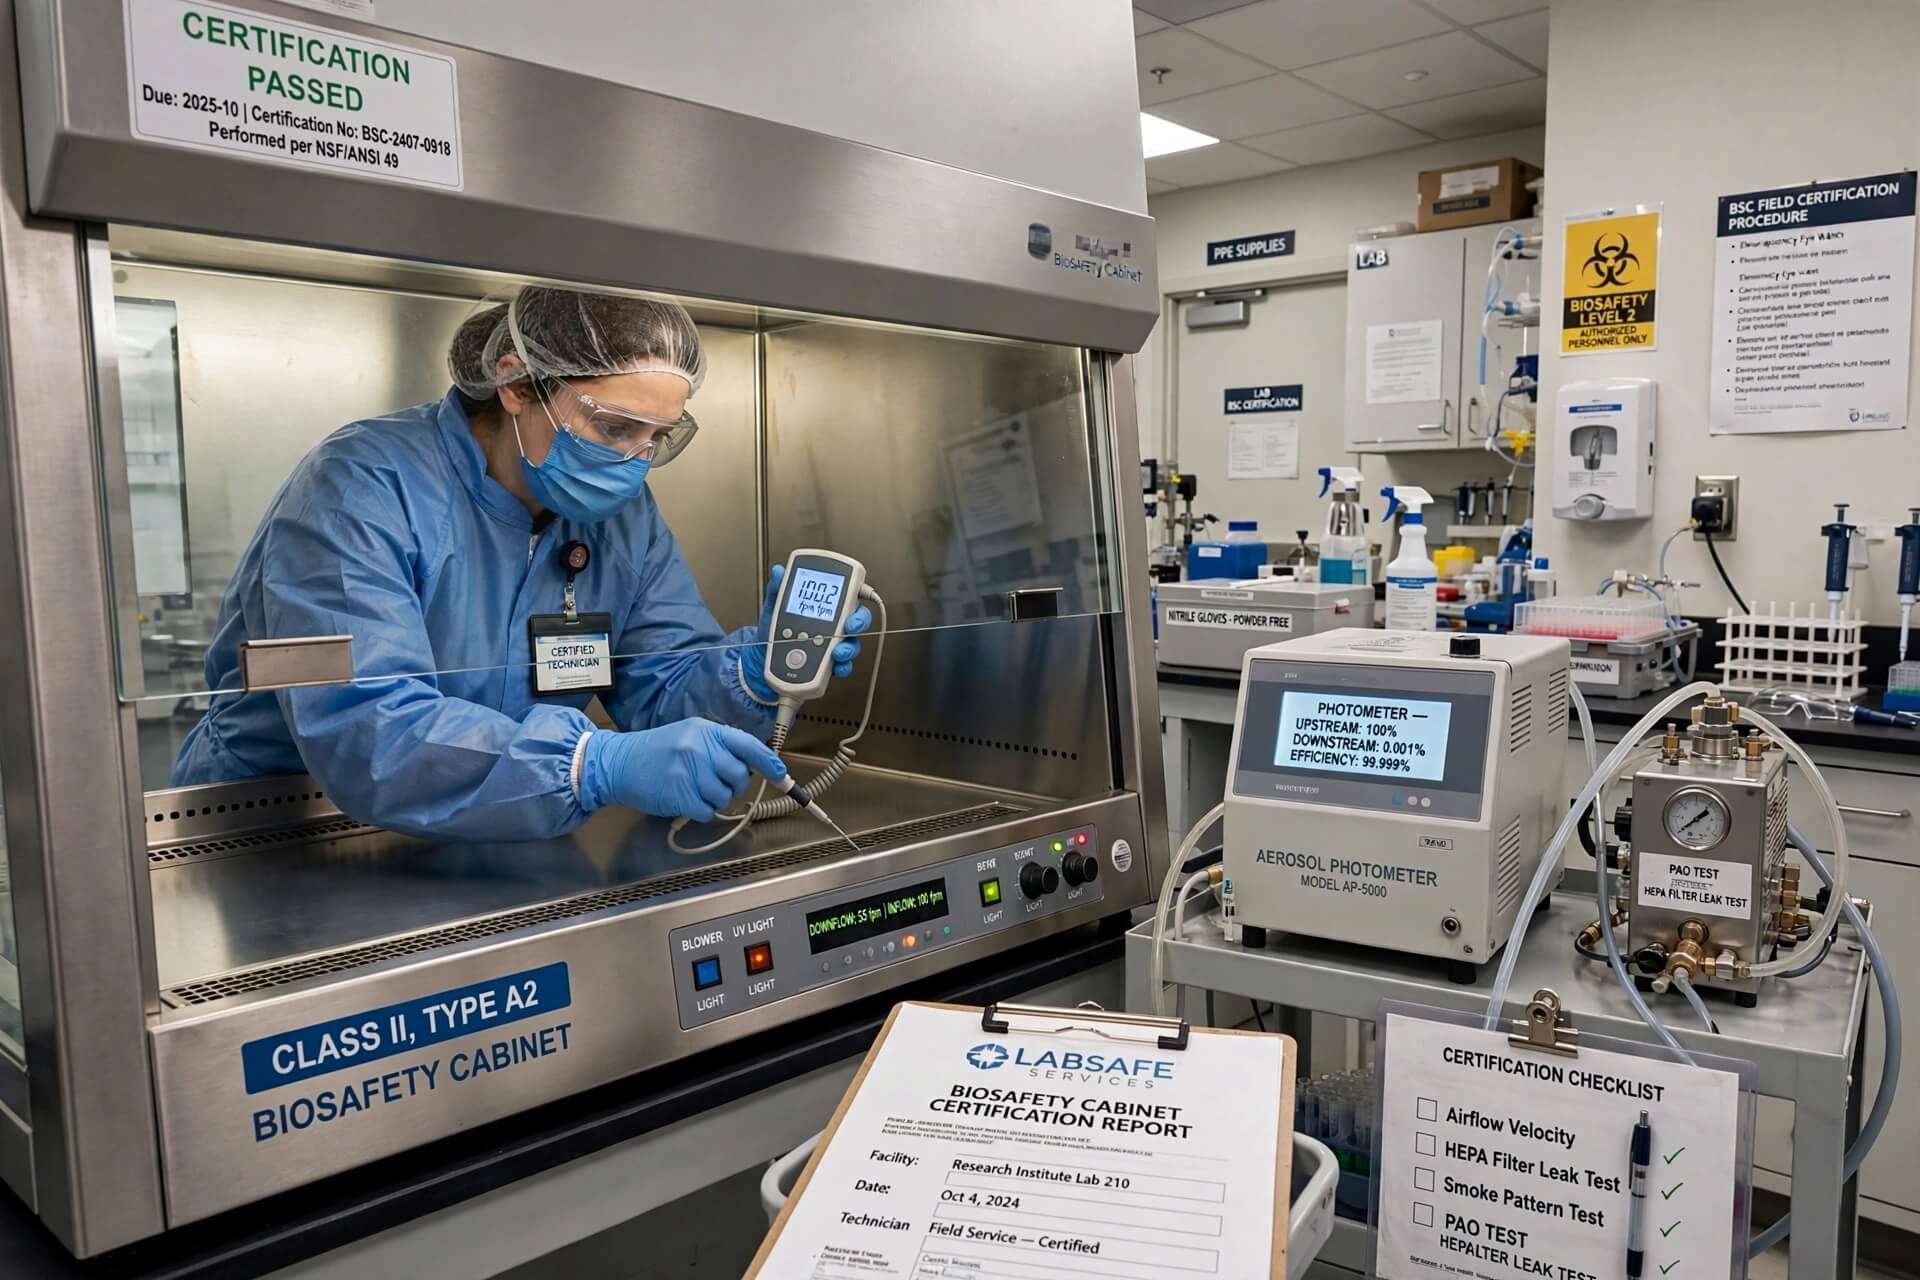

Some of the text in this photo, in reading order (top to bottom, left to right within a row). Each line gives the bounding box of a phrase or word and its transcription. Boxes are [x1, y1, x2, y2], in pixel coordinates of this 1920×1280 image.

[183, 12, 410, 84] CERTIFICATION
[248, 66, 363, 111] PASSED
[143, 84, 178, 107] Due:
[183, 93, 238, 117] 2025-10
[252, 106, 333, 135] Certification
[336, 120, 358, 139] No:
[362, 125, 451, 156] BSC-2407-0918
[209, 122, 399, 168] Performed per NSF/ANSI 49
[1729, 182, 1899, 215] BSC FIELD CERTIFICATION
[1728, 209, 1808, 230] PROCEDURE
[1214, 237, 1286, 260] PPE SUPPLIES
[1358, 249, 1387, 268] LAB
[1570, 293, 1648, 312] BIOSAFETY
[1580, 309, 1636, 325] LEVEL 2
[1568, 334, 1647, 348] PERSONNEL ONLY
[1580, 326, 1637, 337] AUTHORIZED
[1168, 610, 1195, 622] NITRILE
[1197, 612, 1227, 624] GLOVES
[1233, 614, 1267, 627] POWDER
[1269, 617, 1289, 628] FREE
[551, 645, 595, 657] CERTIFIED
[547, 658, 600, 670] TECHNICIAN
[1318, 702, 1408, 720] PHOTOMETER
[1296, 717, 1397, 737] UPSTREAM: 100%
[1293, 733, 1425, 757] DOWNSTREAM: 0.001%
[1290, 749, 1410, 772] EFFICIENCY: 99.999%
[1256, 848, 1438, 887] AEROSOL PHOTOMETER
[1669, 864, 1719, 880] PAO TEST
[1301, 874, 1387, 898] MODEL AP-5000
[1644, 886, 1747, 908] HEPA FILTER LEAK TEST
[732, 916, 775, 938] UV LIGHT
[681, 931, 724, 951] BLOWER
[748, 978, 776, 996] LIGHT
[697, 993, 725, 1012] LIGHT
[272, 979, 539, 1076] CLASS II, TYPE A2
[1015, 1047, 1175, 1080] LABSAFE
[1443, 1047, 1665, 1102] CERTIFICATION CHECKLIST
[253, 1022, 572, 1143] BIOSAFETY CABINET
[1029, 1068, 1155, 1089] SERVICES
[950, 1084, 1183, 1121] BIOSAFETY CABINET
[929, 1098, 1095, 1128] CERTIFICATION
[1101, 1117, 1193, 1140] REPORT
[1446, 1107, 1576, 1149] Airflow Velocity
[870, 1149, 920, 1167] Facility:
[1445, 1141, 1621, 1194] HEPA Filter Leak Test
[951, 1158, 1130, 1190] Research Institute Lab 210
[854, 1179, 891, 1195] Date:
[940, 1189, 1020, 1209] Oct 4, 2024
[1444, 1176, 1604, 1228] Smoke Pattern Test
[840, 1212, 910, 1231] Technician
[1445, 1213, 1528, 1248] PAO TEST
[928, 1222, 962, 1237] Field
[966, 1226, 1017, 1244] Service
[1038, 1236, 1100, 1255] Certified
[1440, 1234, 1509, 1265] HEPALTER
[1514, 1254, 1553, 1278] LEAK
